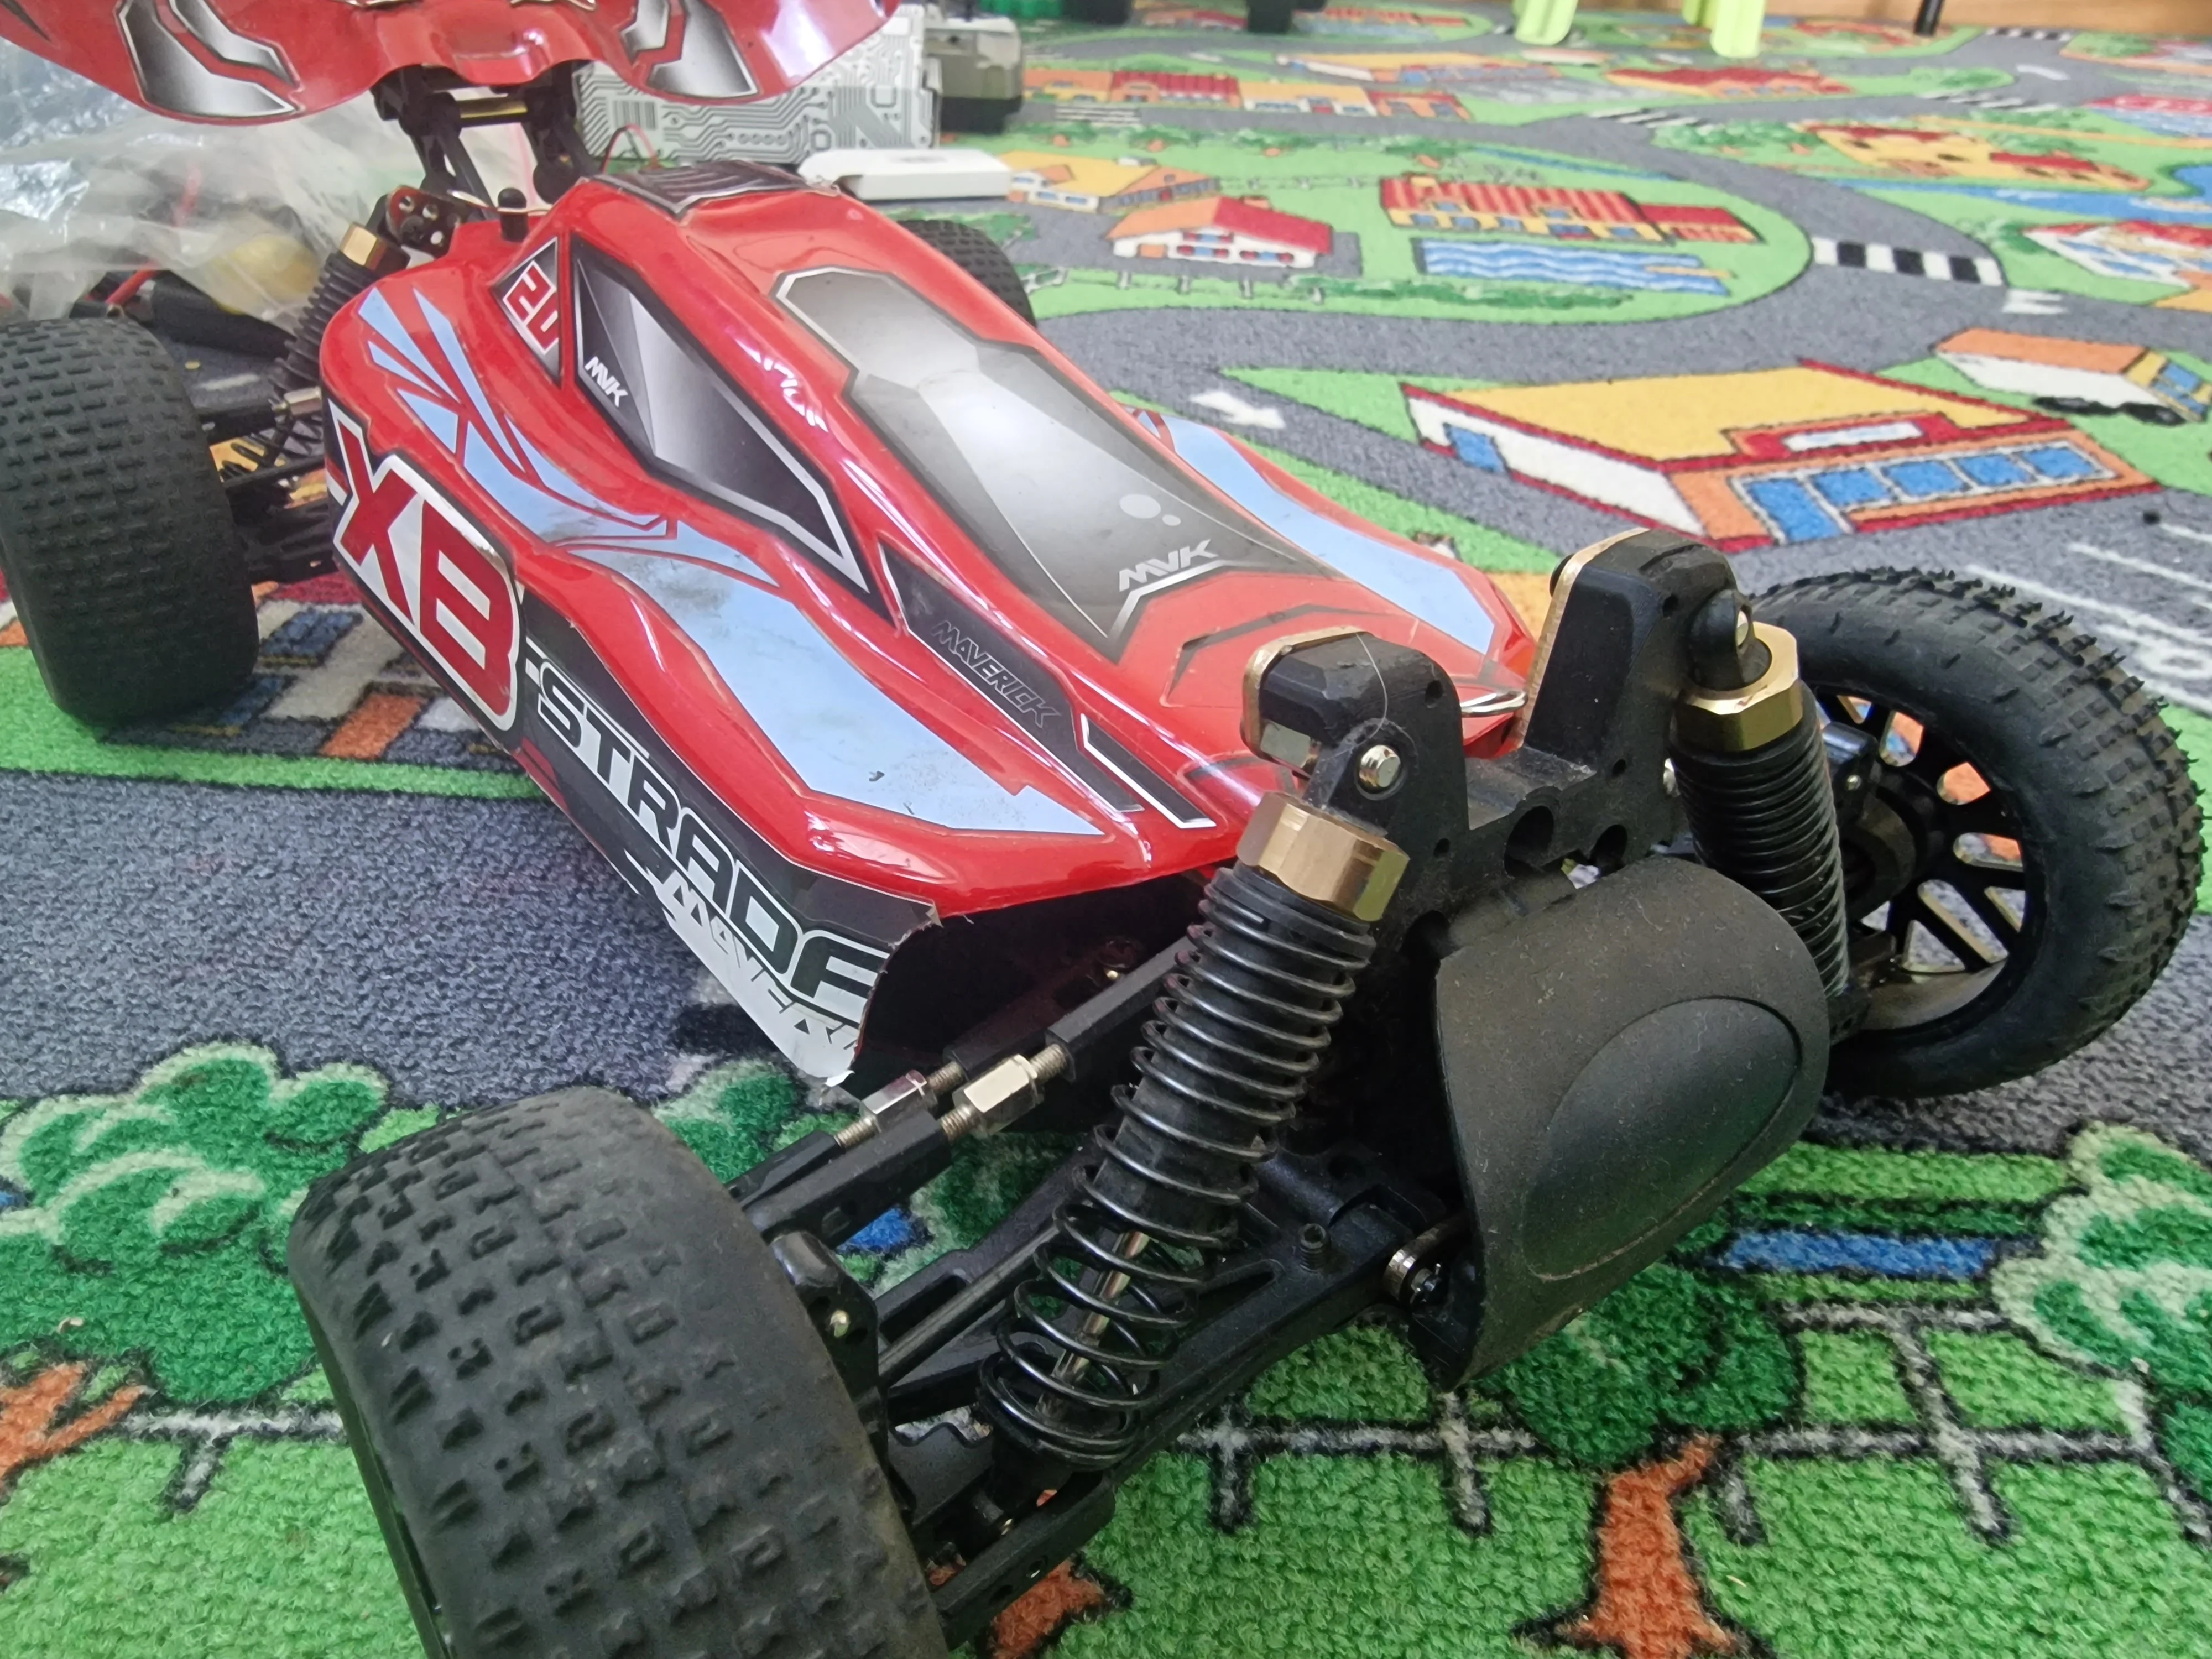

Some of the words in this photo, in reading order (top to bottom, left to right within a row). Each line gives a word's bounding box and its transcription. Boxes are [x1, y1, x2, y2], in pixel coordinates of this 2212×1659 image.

[585, 356, 628, 407] MVK
[333, 408, 518, 726] XB
[1119, 539, 1219, 592] MVK
[931, 620, 1061, 728] MAVERICK
